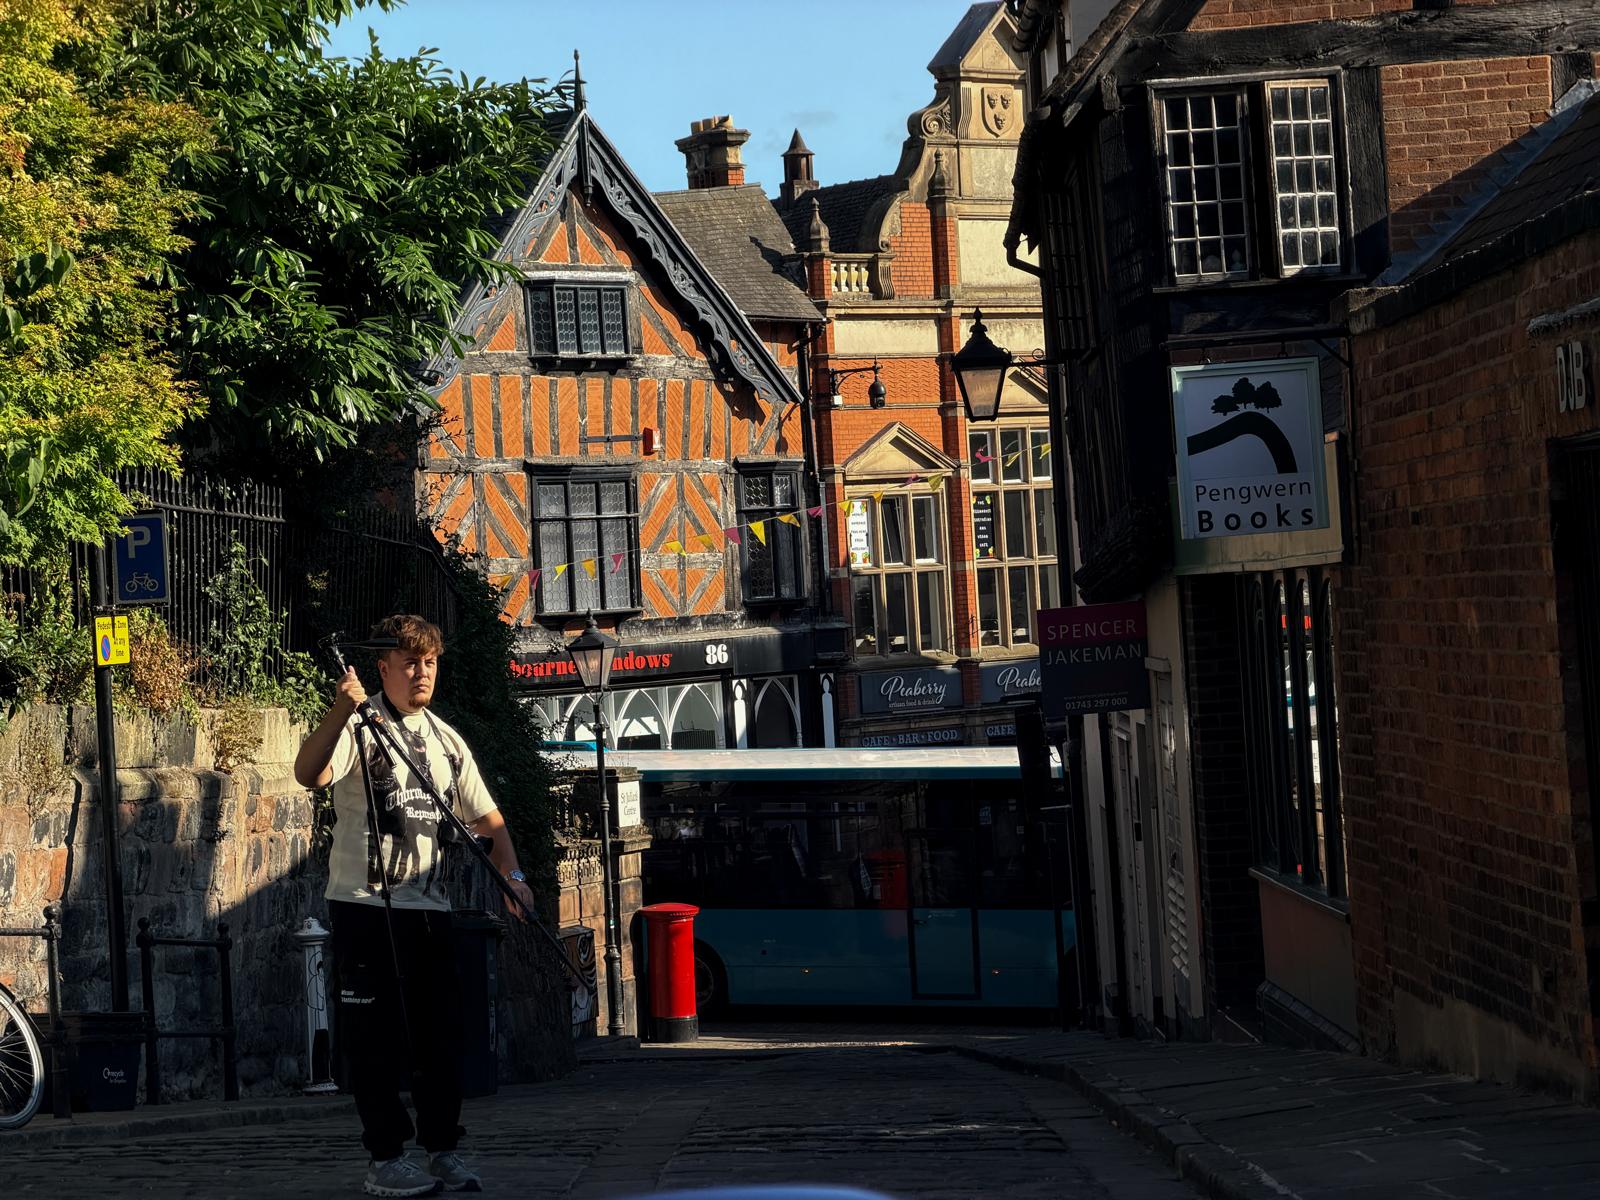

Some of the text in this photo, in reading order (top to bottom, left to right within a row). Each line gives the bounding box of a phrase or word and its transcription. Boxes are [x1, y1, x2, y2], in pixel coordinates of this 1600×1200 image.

[1196, 481, 1311, 504] Pengwern
[1197, 503, 1314, 532] Books
[127, 525, 151, 559] P
[1047, 619, 1137, 641] SPENCER
[602, 651, 673, 671] ndows
[705, 644, 729, 665] 86
[1046, 643, 1142, 666] JAKEMAN
[880, 675, 947, 704] Peaberry
[996, 666, 1041, 692] Peabe
[1065, 697, 1127, 710] 01743 297 000
[898, 732, 920, 745] BAR
[927, 729, 958, 741] FOOD
